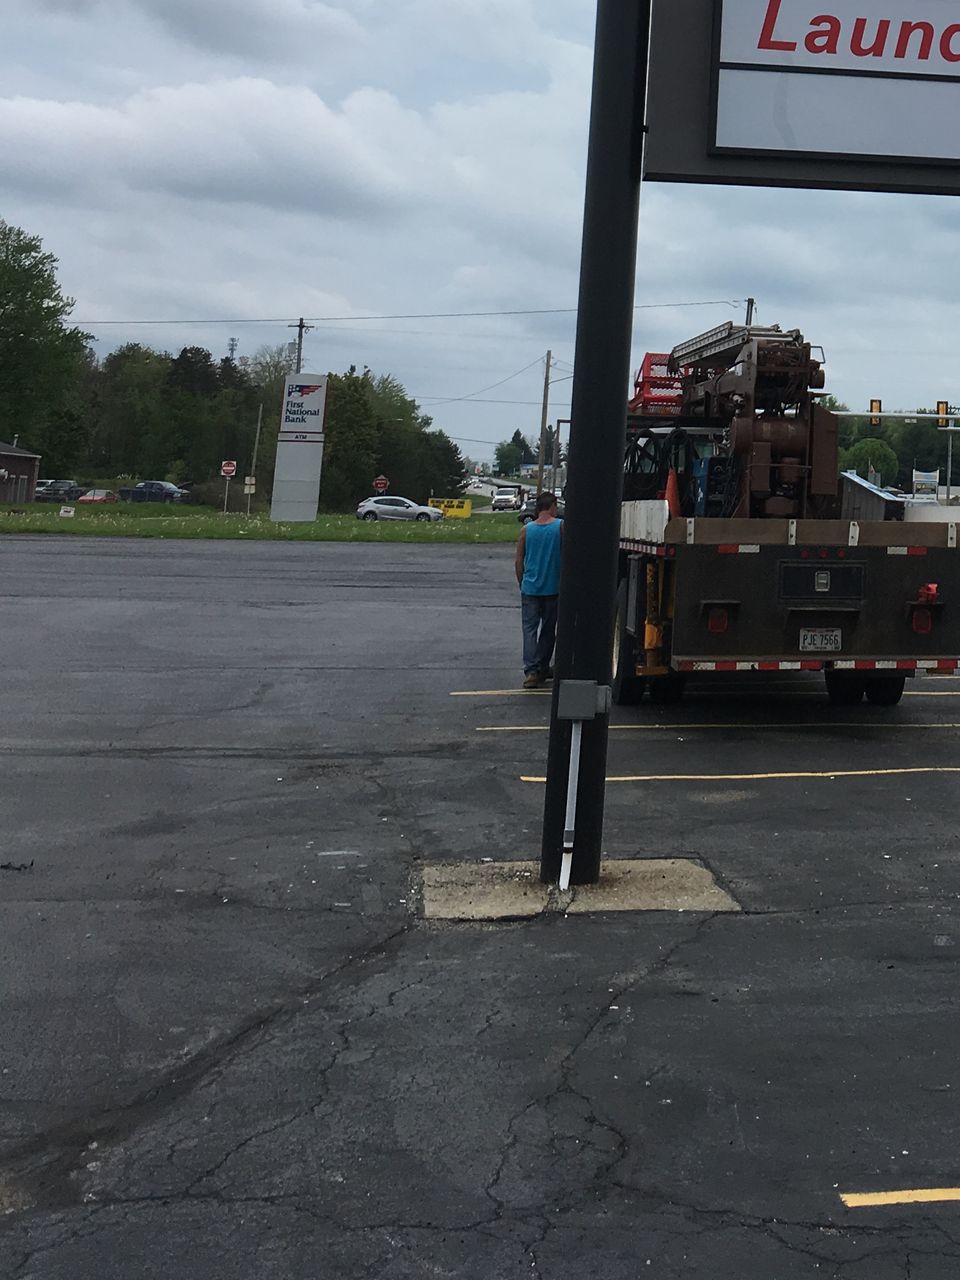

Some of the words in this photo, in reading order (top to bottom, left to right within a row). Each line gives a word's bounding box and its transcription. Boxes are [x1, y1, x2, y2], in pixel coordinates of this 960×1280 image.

[286, 401, 304, 409] First
[802, 633, 817, 646] PJE
[819, 634, 839, 646] 7566
